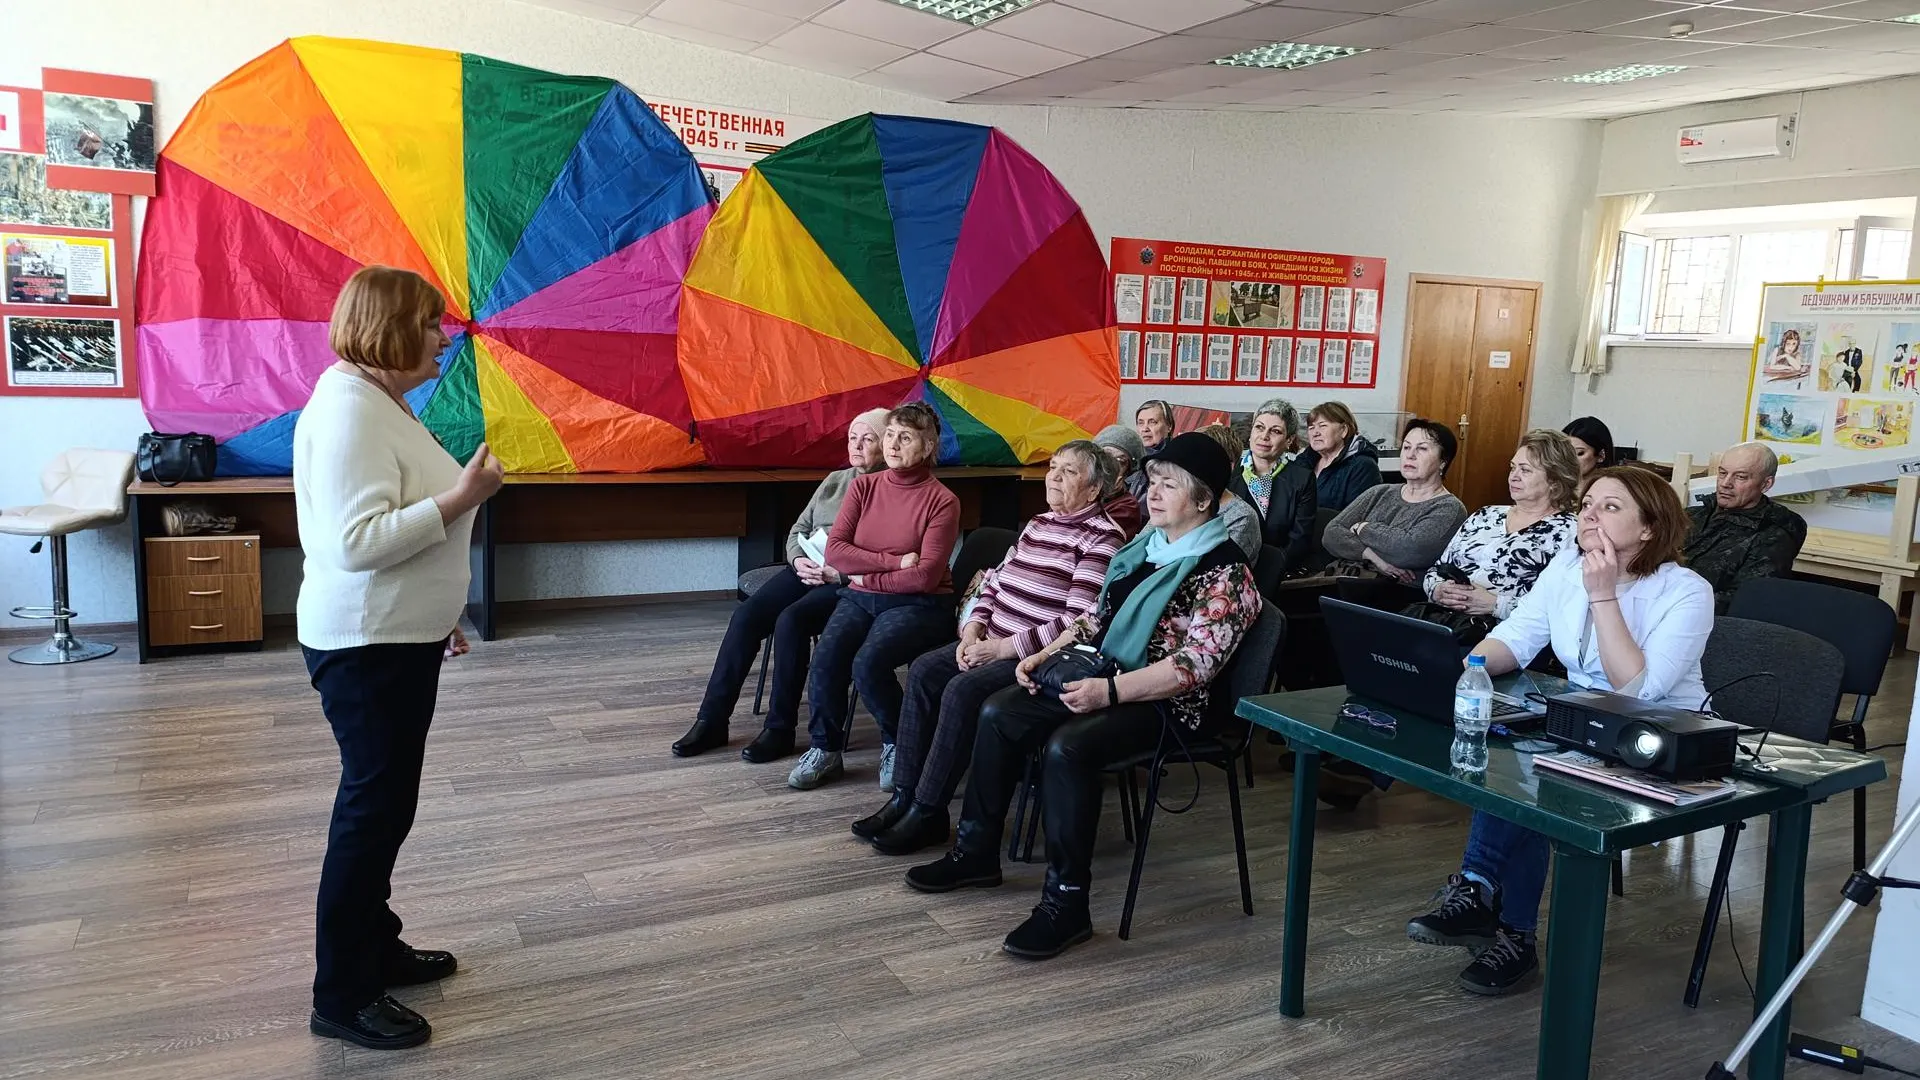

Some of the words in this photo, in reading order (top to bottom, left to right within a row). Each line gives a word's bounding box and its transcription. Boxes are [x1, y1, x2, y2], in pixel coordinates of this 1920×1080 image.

[647, 102, 785, 138] ТЕЧЕСТВЕННАЯ
[1163, 254, 1207, 265] БРОННИЦЫ,
[1208, 258, 1240, 267] ПАВШИМ
[1248, 261, 1269, 270] БОЯХ,
[1270, 262, 1308, 273] УШЕДШИМ
[1319, 266, 1344, 275] ЖИЗНИ
[1174, 246, 1216, 257] СОЛДАТАМ,
[1217, 248, 1260, 259] СЕРЖАНТАМ
[1267, 252, 1308, 262] ОФИЦЕРАМ
[1308, 255, 1335, 265] ГОРОДА
[1160, 264, 1186, 273] ПОСЛЕ
[1187, 265, 1213, 275] ВОЙНЫ
[1268, 272, 1296, 281] ЖИВЫМ
[1297, 274, 1347, 284] ПОСВЯЩАЕТСЯ
[1801, 293, 1850, 306] ДЕДУШКАМ
[1851, 293, 1858, 305] И
[1860, 292, 1913, 306] БАБУШКАМ
[1370, 652, 1420, 674] TOSHIBA
